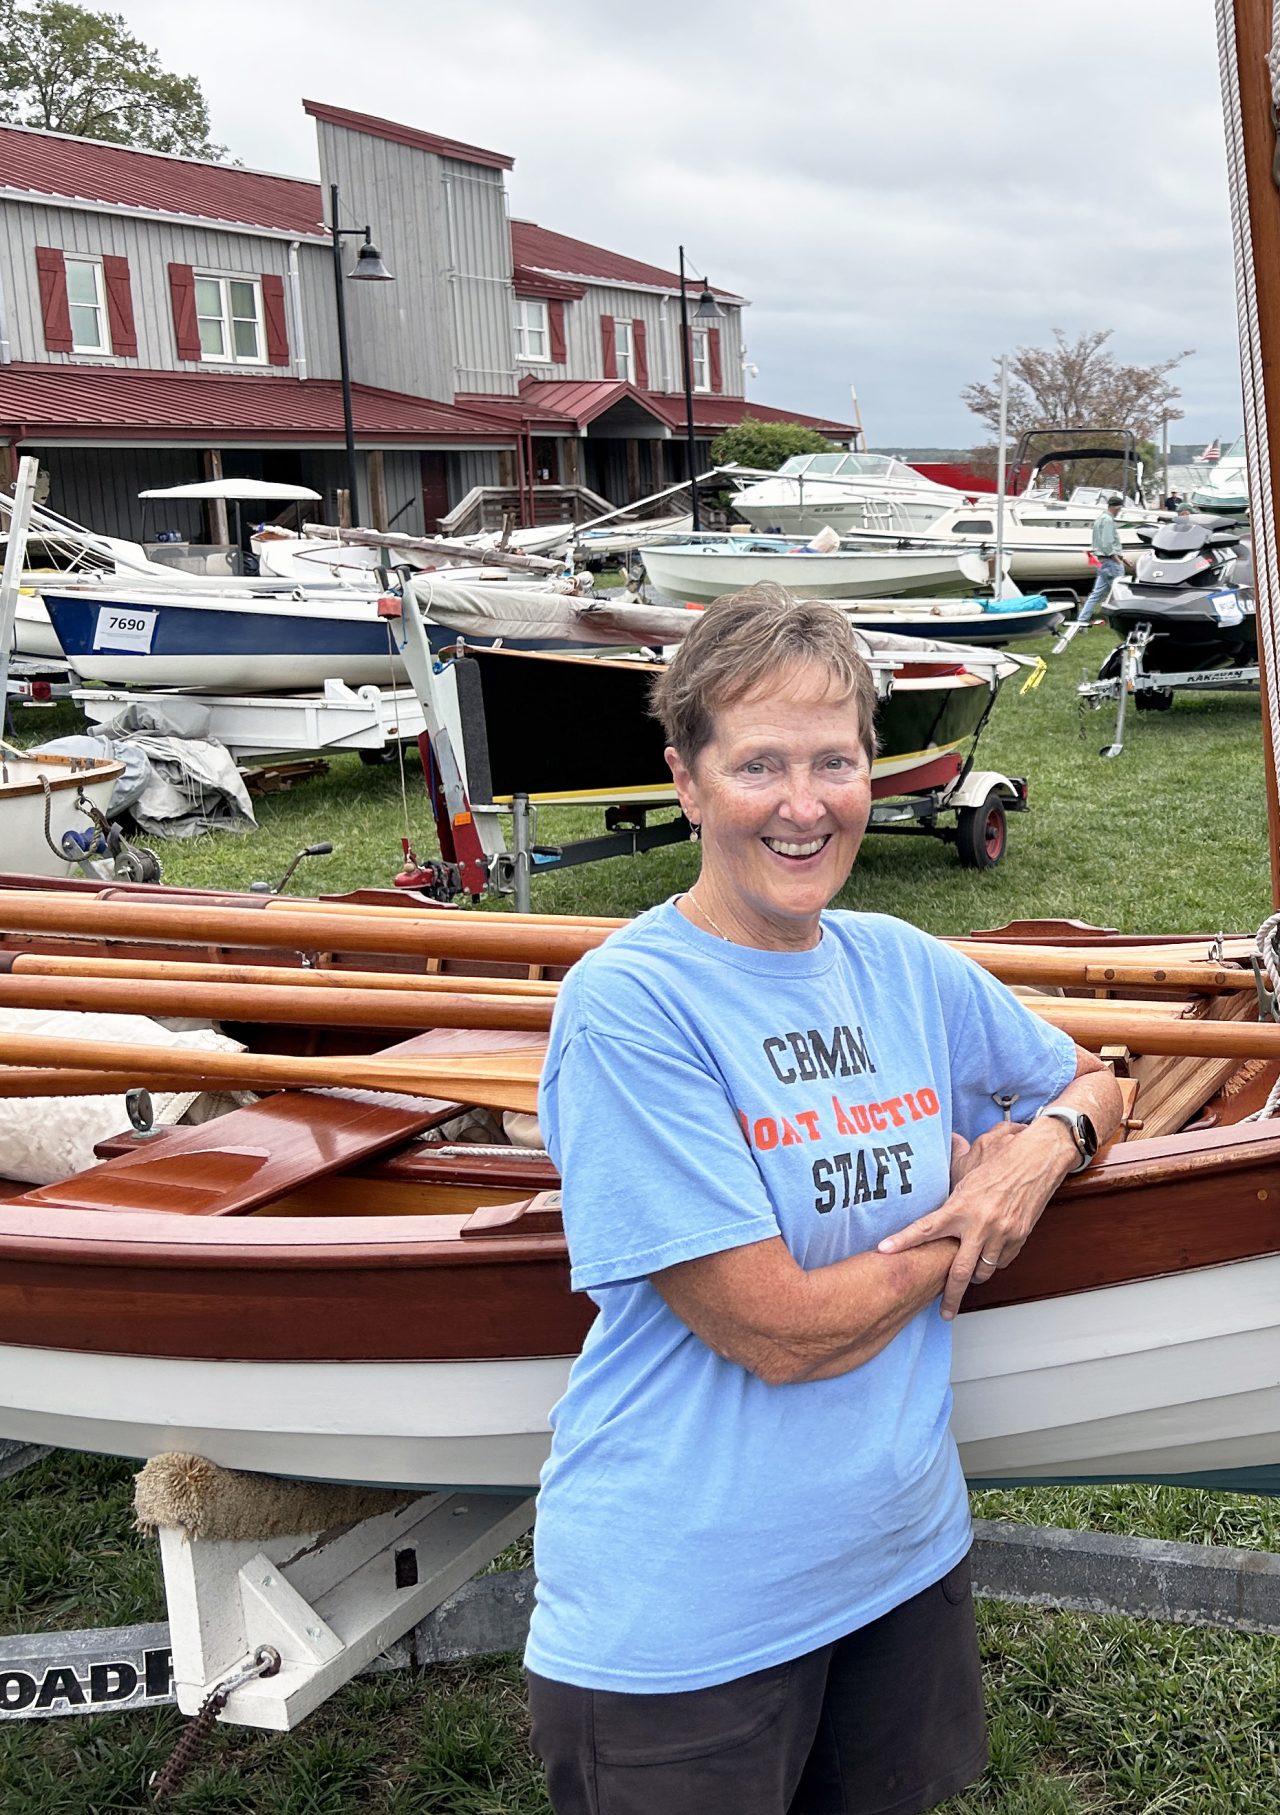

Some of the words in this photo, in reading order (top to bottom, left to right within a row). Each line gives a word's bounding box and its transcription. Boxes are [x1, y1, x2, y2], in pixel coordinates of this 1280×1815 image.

[109, 617, 146, 632] 7690
[762, 1026, 877, 1085] CBMM
[831, 1087, 941, 1136] AUCTIO
[812, 1142, 915, 1215] STAFF
